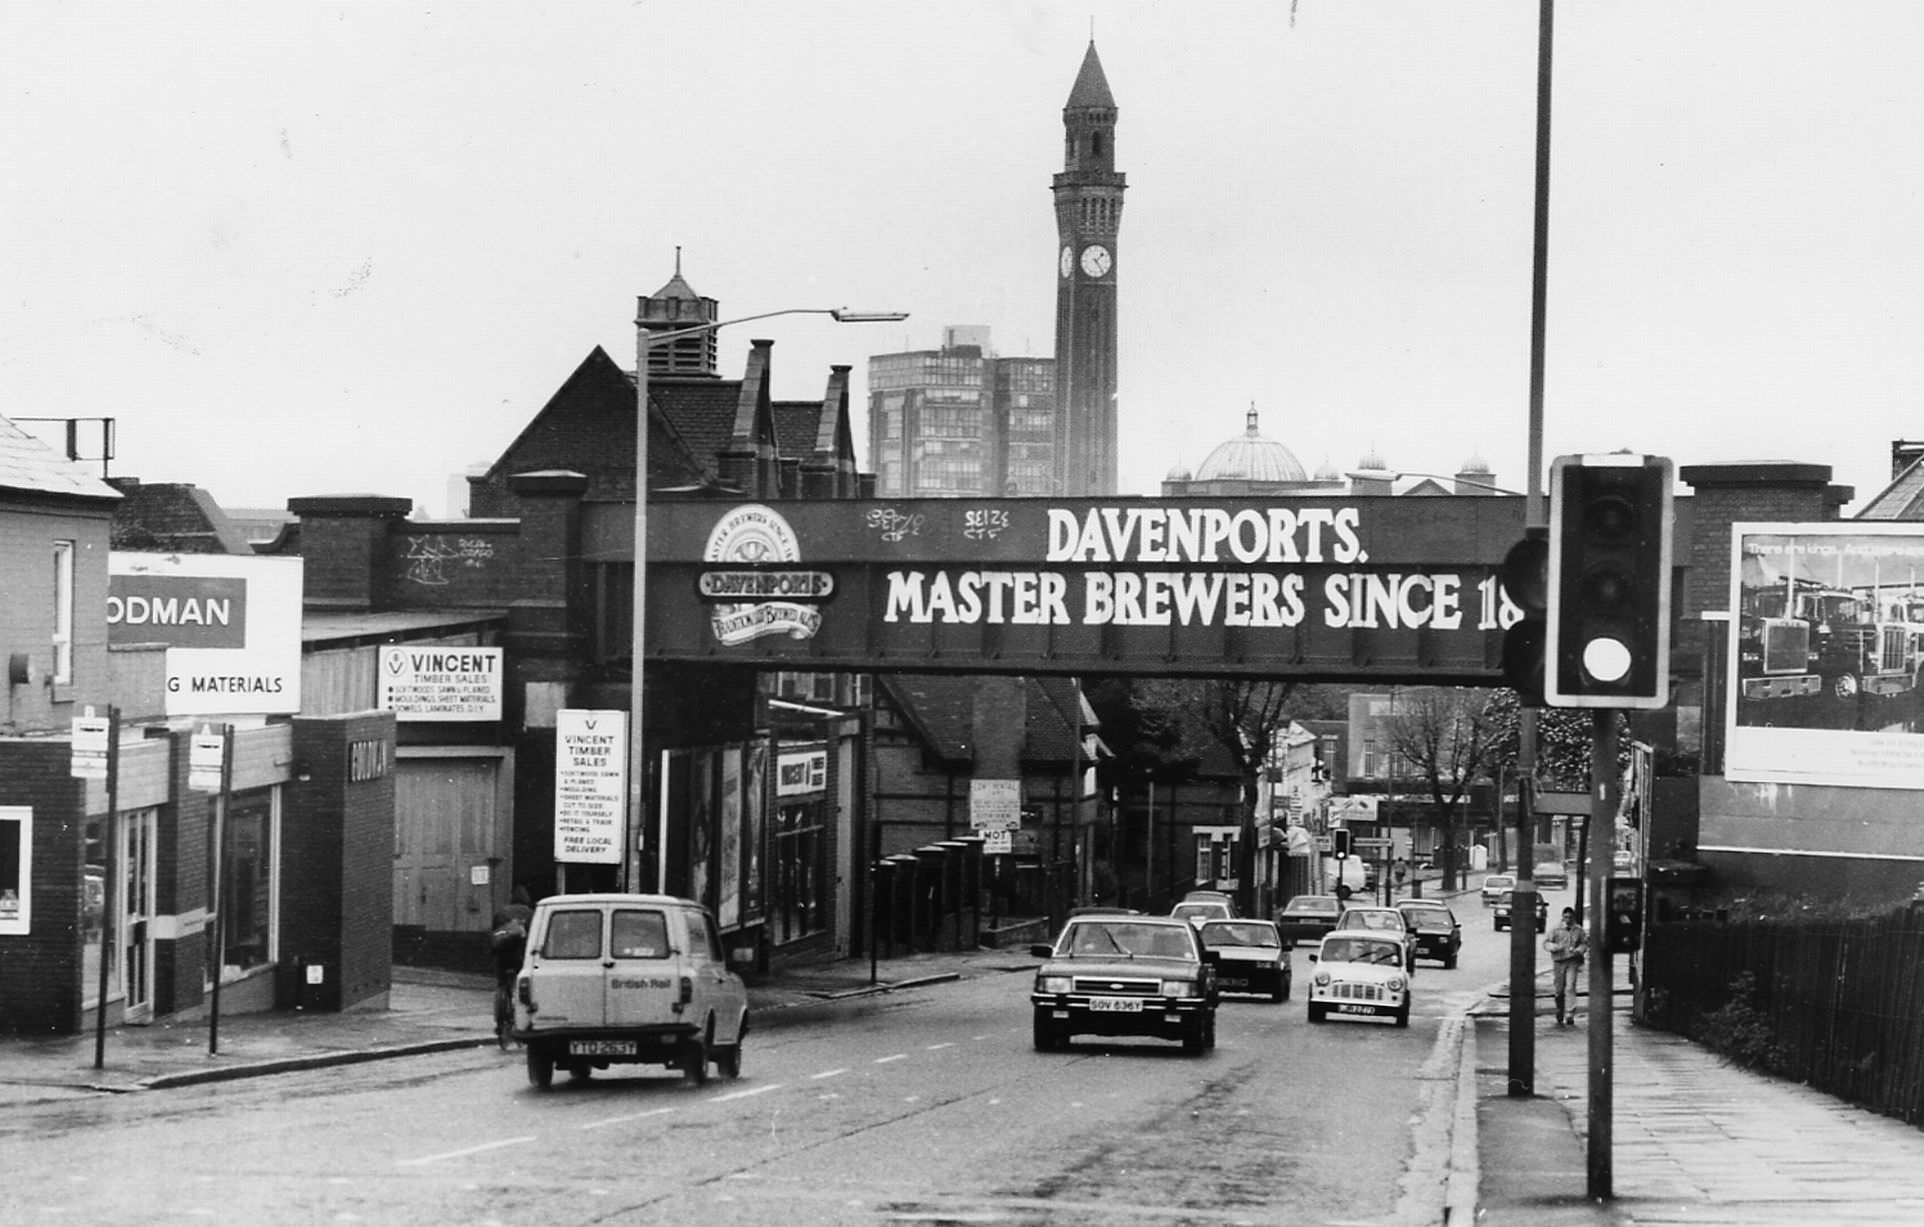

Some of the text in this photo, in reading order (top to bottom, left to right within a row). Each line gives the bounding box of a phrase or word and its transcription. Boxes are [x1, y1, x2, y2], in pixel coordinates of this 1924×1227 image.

[1046, 507, 1369, 563] DAVENPORTS.
[883, 570, 1070, 625] MASTER
[1083, 572, 1305, 628] BREWERS
[1323, 572, 1463, 629] SINCE
[411, 654, 496, 673] VINCENT
[414, 674, 488, 684] TIMBER SALES
[191, 677, 283, 693] MATERIALS
[564, 735, 615, 745] VINCENT
[568, 746, 611, 756] TIMBER
[573, 757, 607, 767] SALES
[564, 836, 612, 845] FREE LOCAL
[565, 845, 606, 853] DELIVERY
[611, 978, 671, 989] British Rail
